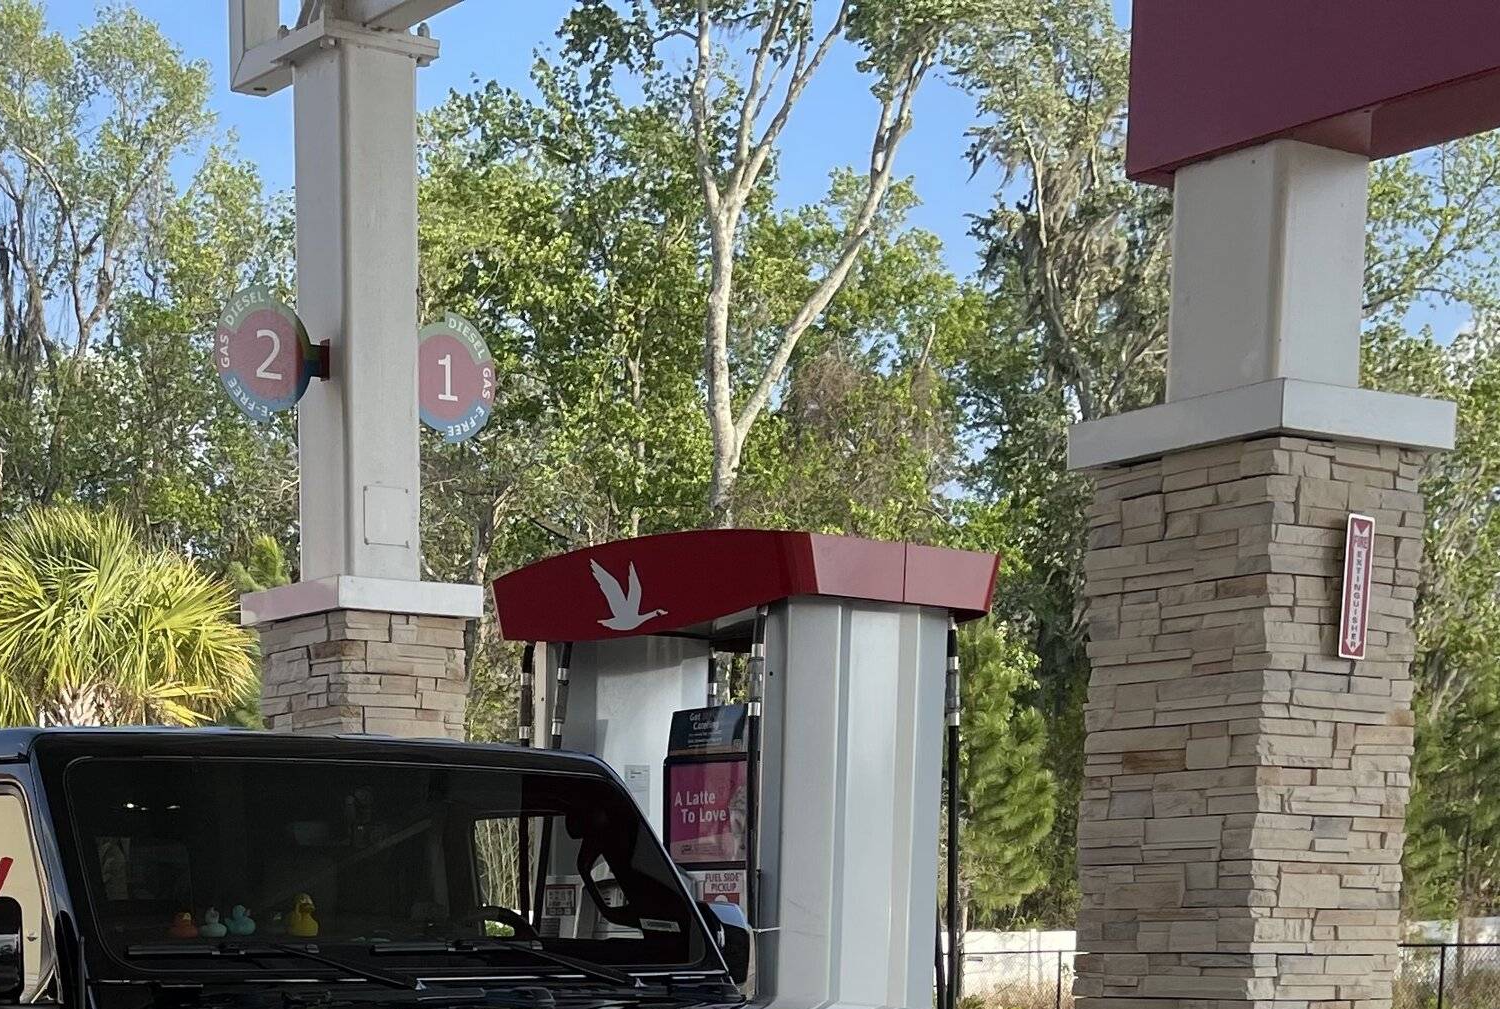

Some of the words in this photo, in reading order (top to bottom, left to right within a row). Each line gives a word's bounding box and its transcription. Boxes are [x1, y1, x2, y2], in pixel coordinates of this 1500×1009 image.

[223, 290, 265, 327] DIESEL
[220, 333, 231, 368] GAS
[255, 329, 282, 381] 2
[446, 316, 487, 359] DIESEL
[437, 353, 459, 402] 1
[481, 366, 492, 400] GAS
[226, 376, 269, 418] E-FREE
[446, 405, 485, 438] E-FREE
[1349, 550, 1363, 648] EXTINGUISHER
[674, 791, 683, 807] A
[686, 790, 716, 806] Latte
[681, 808, 696, 824] To
[699, 807, 727, 824] Love
[705, 873, 723, 883] FUEL
[724, 872, 740, 882] SIDE
[711, 883, 737, 892] PICKUP
